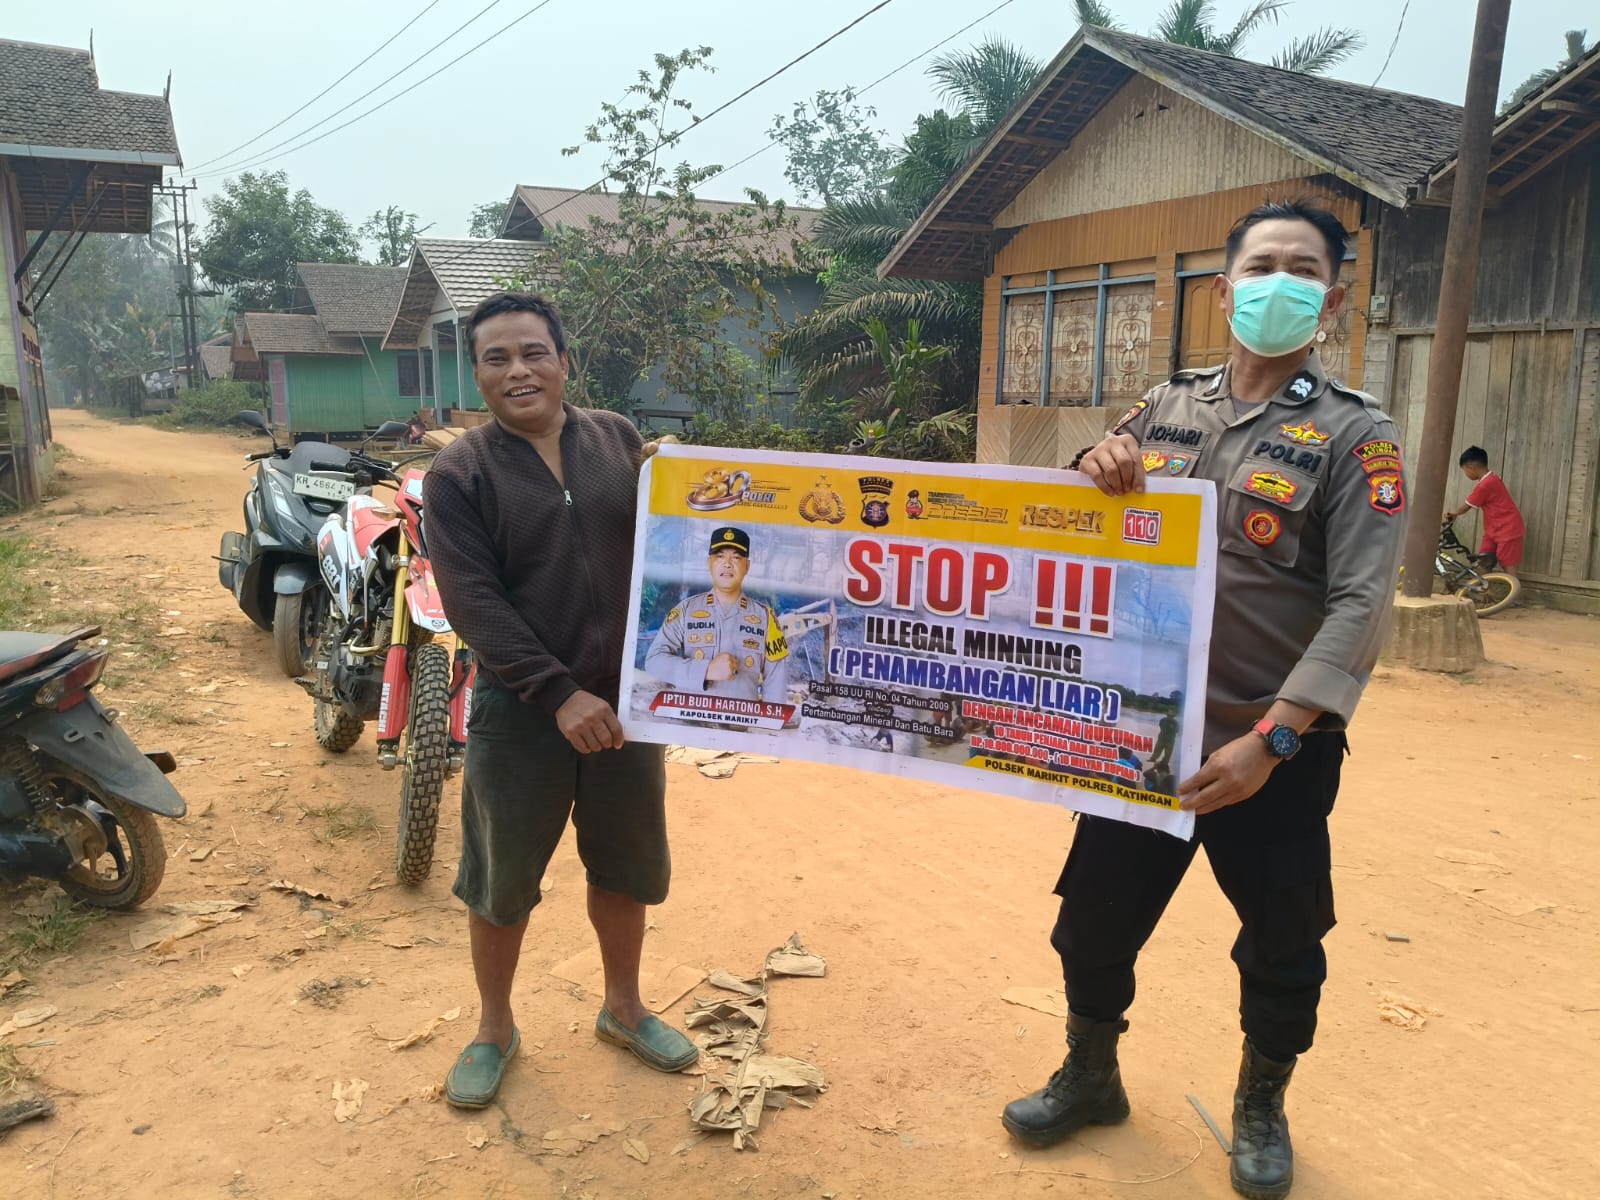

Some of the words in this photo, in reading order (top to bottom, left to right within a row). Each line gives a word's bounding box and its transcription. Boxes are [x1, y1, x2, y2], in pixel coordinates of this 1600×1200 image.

[1146, 425, 1202, 446] JOHARI
[1253, 440, 1322, 473] POLRI
[296, 475, 309, 485] KH
[741, 491, 777, 503] POLRI
[1021, 504, 1107, 533] RESPEK
[1127, 517, 1157, 537] 110
[846, 538, 1010, 618] STOP
[1034, 558, 1113, 635] !!!
[739, 624, 765, 636] POLRI
[866, 615, 957, 655] ILLEGAL
[963, 629, 1082, 675] MINNING
[378, 682, 391, 733] HITACHI
[662, 693, 686, 706] IPTU
[688, 696, 712, 709] BUDI
[715, 698, 763, 716] HARTONO,
[766, 705, 785, 718] S.H.
[811, 682, 832, 694] Pasal
[835, 686, 849, 696] 158
[850, 688, 863, 698] UU
[865, 690, 874, 699] RI
[875, 691, 889, 702] No.
[891, 693, 901, 703] 04
[902, 695, 928, 708] Tahun
[929, 699, 950, 711] 2009
[679, 709, 723, 720] KAPOLSEK
[724, 714, 759, 725] MARIKIT
[803, 706, 862, 723] Pertambangan
[863, 714, 893, 728] Mineral
[895, 719, 911, 731] Dan
[912, 721, 932, 734] Batu
[934, 725, 954, 738] Bara
[962, 702, 1014, 724] DENGAN
[1015, 709, 1082, 738] ANCAMAN
[1083, 724, 1154, 753] HUKUMAN
[1006, 727, 1033, 743] TAHUN
[1069, 740, 1088, 756] DAN
[984, 759, 1024, 775] POLSEK
[1026, 768, 1069, 784] MARIKIT
[1072, 777, 1114, 793] POLRES
[1116, 785, 1172, 808] KATINGAN
